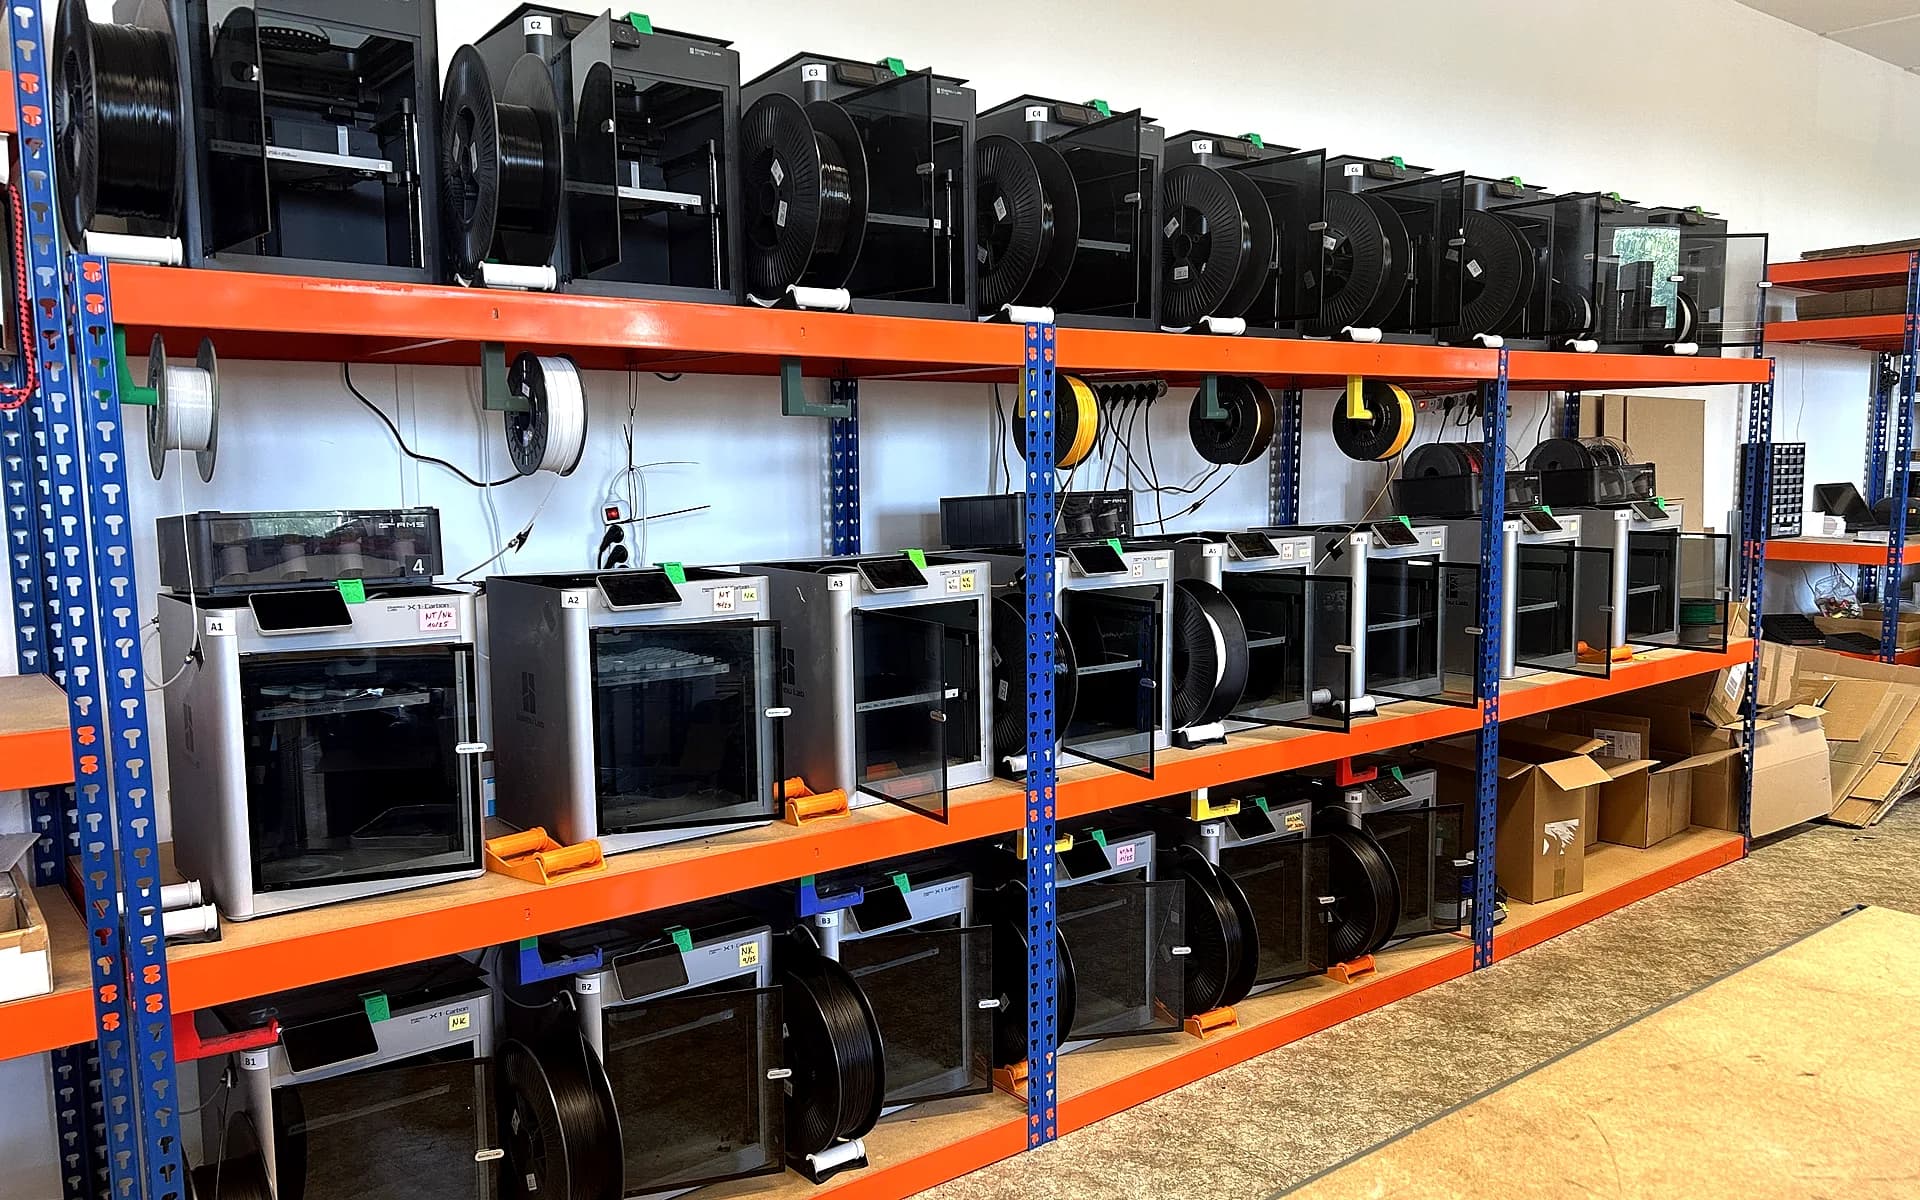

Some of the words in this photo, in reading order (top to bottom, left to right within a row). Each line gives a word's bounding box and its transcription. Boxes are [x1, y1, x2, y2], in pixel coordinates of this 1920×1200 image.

[530, 21, 542, 30] C2
[808, 69, 818, 77] C3
[1032, 110, 1041, 118] C4
[1120, 523, 1127, 535] 1
[412, 558, 425, 574] 4
[833, 580, 843, 588] A3
[568, 596, 580, 604] A2
[425, 610, 453, 620] NT/NK
[210, 622, 224, 631] A1
[821, 917, 831, 925] B3
[741, 945, 755, 956] NK
[581, 983, 592, 991] B2
[452, 1017, 467, 1028] NK
[245, 1057, 257, 1066] B1
